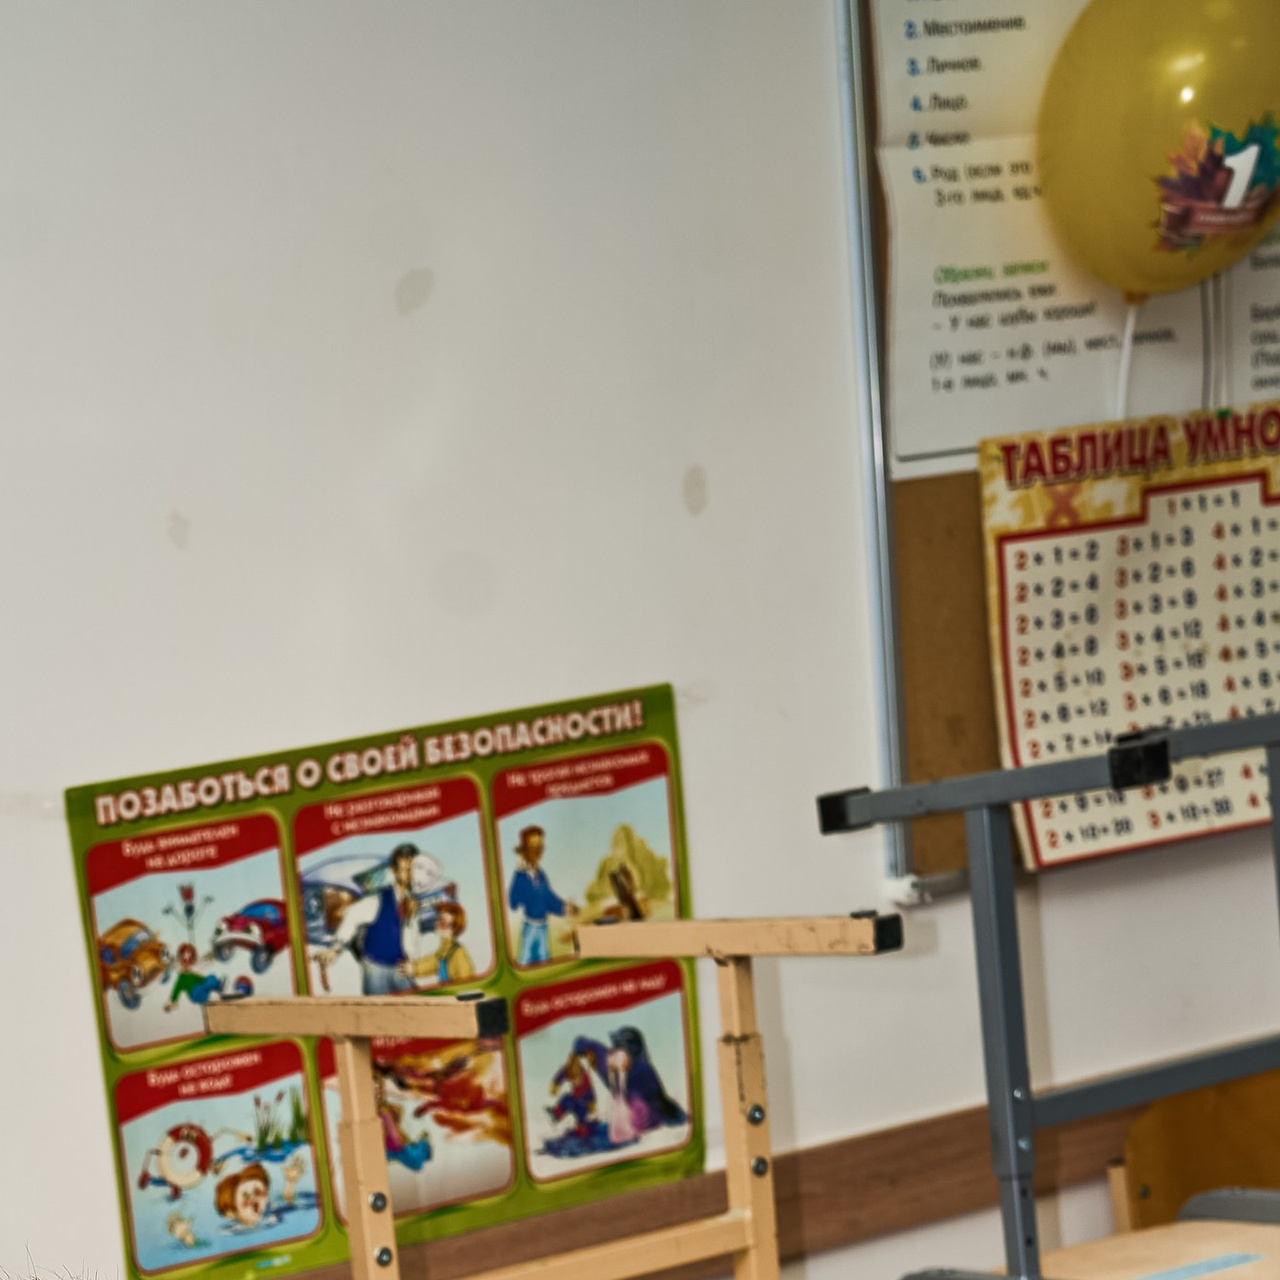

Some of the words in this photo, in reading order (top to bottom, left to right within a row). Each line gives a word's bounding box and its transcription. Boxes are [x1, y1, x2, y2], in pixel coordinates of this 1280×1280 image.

[1224, 143, 1261, 209] 1
[999, 422, 1173, 489] ТАБЛИЦА
[95, 763, 291, 826] ПОЗАБОТЬСЯ
[296, 758, 321, 789] О
[326, 734, 419, 783] СВОЕЙ
[425, 699, 645, 765] БЕЗОПАСНОСТИ!
